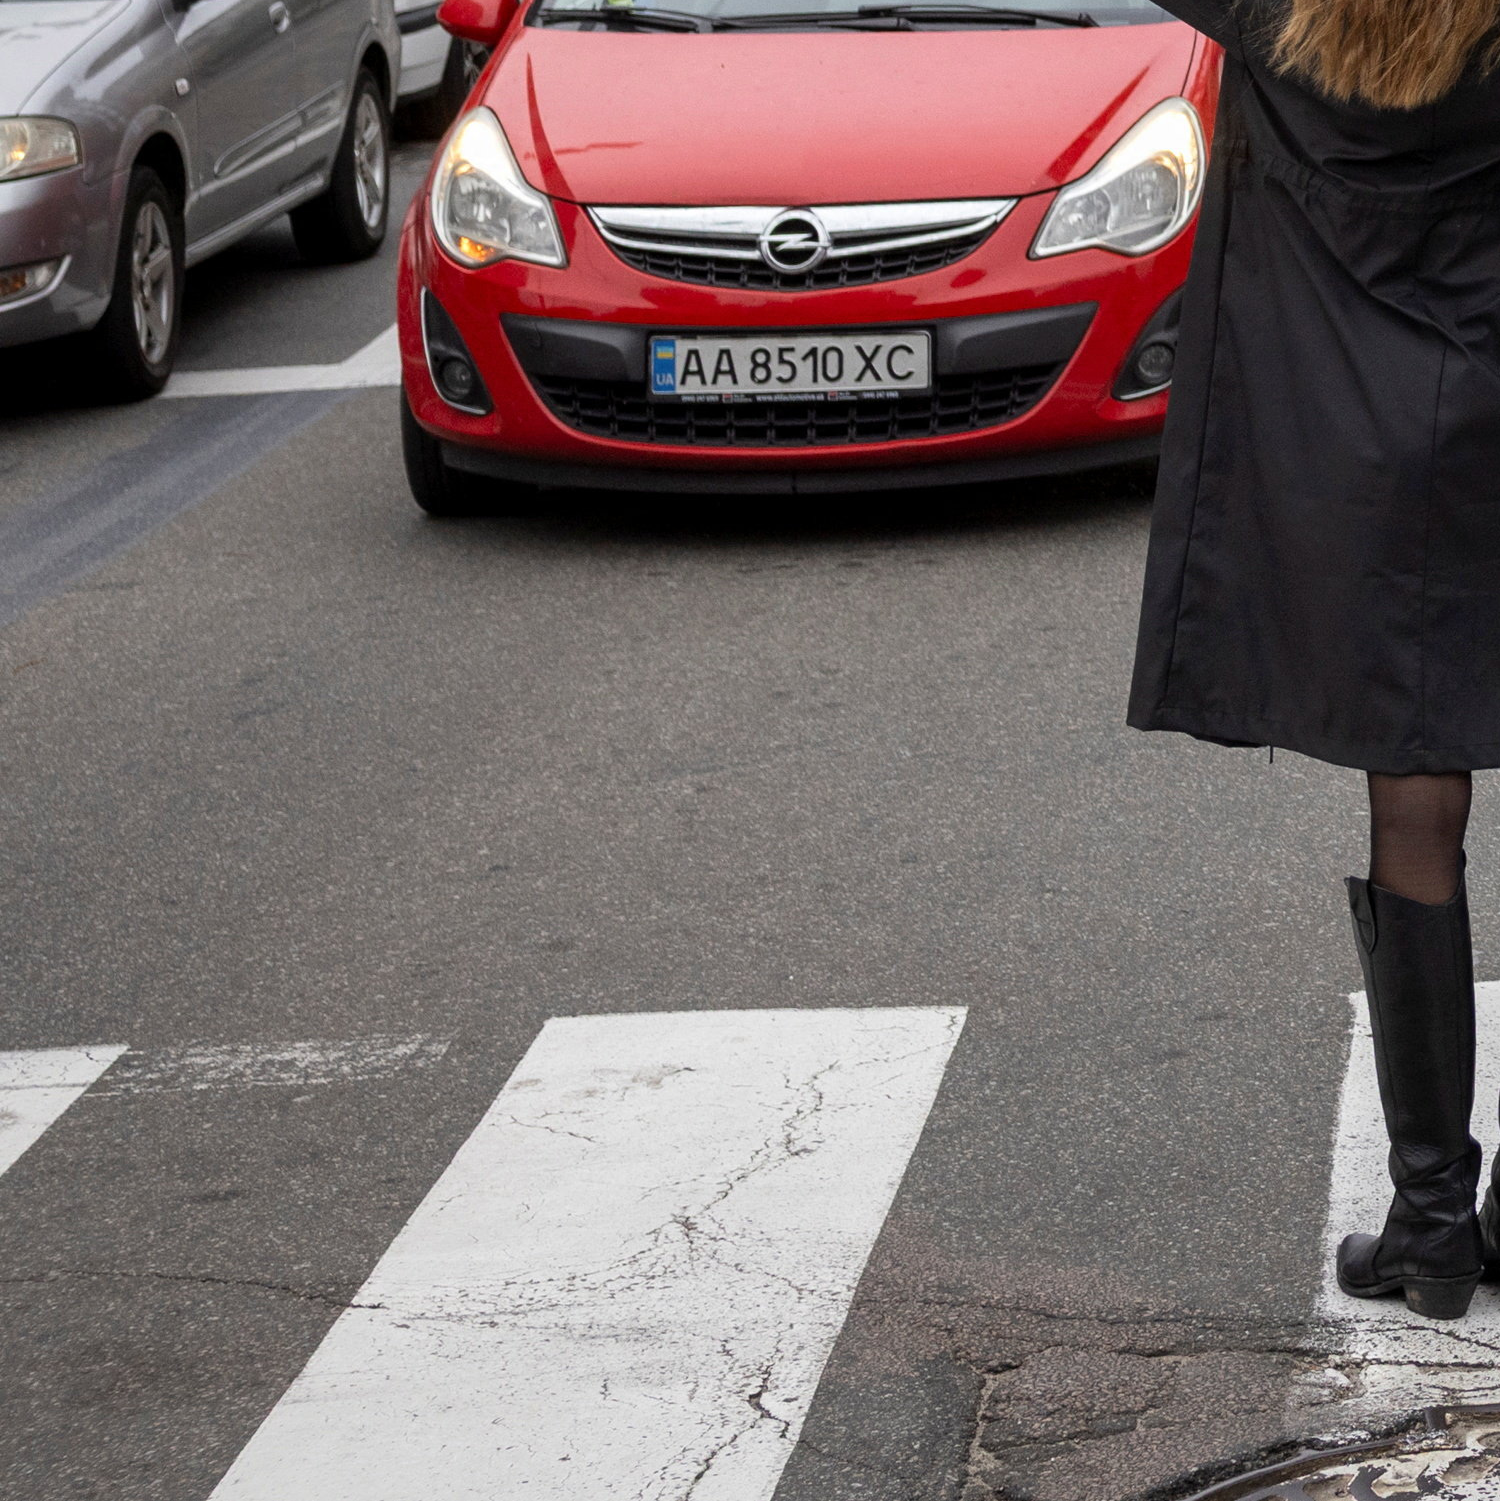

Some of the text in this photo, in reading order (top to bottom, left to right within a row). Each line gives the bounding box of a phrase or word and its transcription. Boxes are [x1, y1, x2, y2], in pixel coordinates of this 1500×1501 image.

[680, 343, 915, 386] AA 8510 XC
[655, 373, 675, 386] UA
